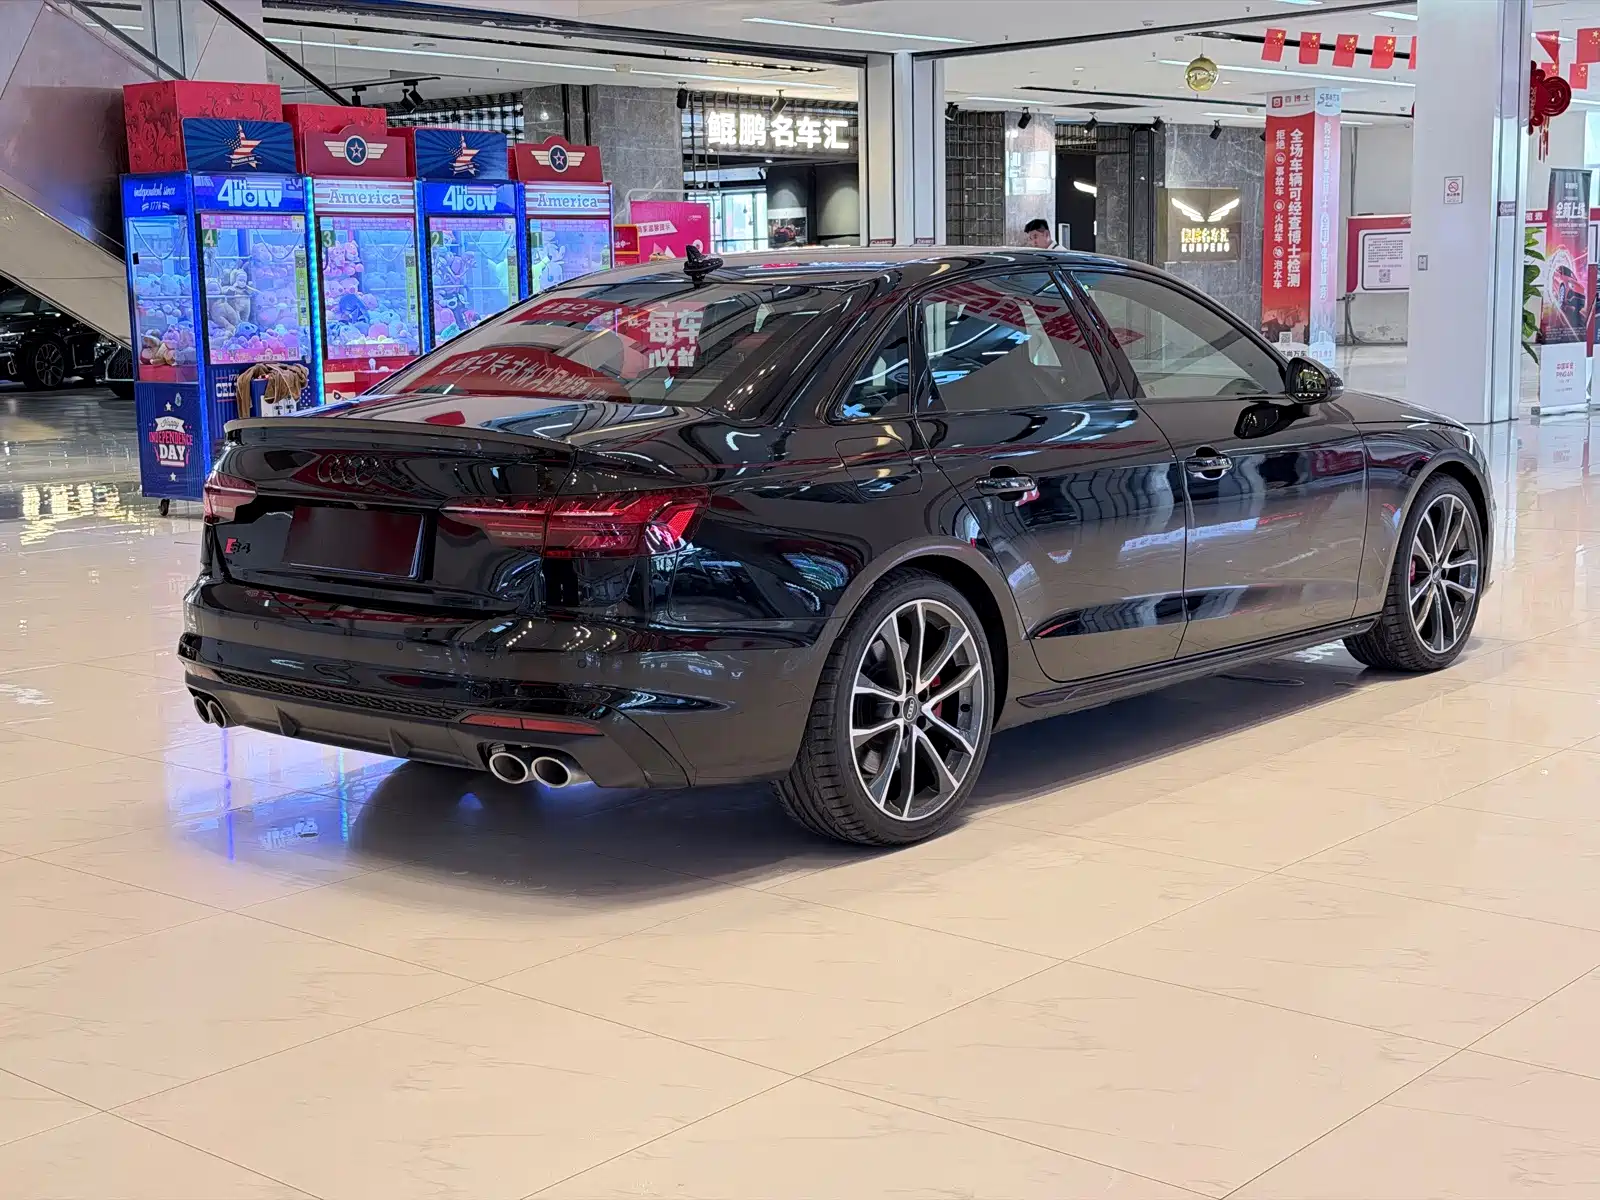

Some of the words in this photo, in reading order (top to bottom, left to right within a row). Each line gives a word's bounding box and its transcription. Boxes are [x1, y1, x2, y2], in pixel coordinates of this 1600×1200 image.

[707, 111, 849, 149] 鲲鹏名车汇
[1275, 129, 1286, 150] 拒绝
[1275, 166, 1285, 197] 事故车
[134, 182, 163, 202] independent
[162, 186, 176, 198] since
[329, 189, 401, 206] America
[537, 193, 599, 209] America
[1287, 128, 1304, 288] 全场车辆可经查博士检测
[1555, 201, 1587, 220] 全新上线
[1274, 213, 1284, 243] 火烧车
[204, 229, 215, 247] 4
[322, 230, 332, 248] 3
[431, 232, 440, 246] 2
[534, 233, 541, 248] 1
[1273, 260, 1283, 290] 泡水车
[161, 418, 180, 430] Happy
[149, 430, 193, 446] INDEPENDENCE
[159, 444, 187, 461] DAY
